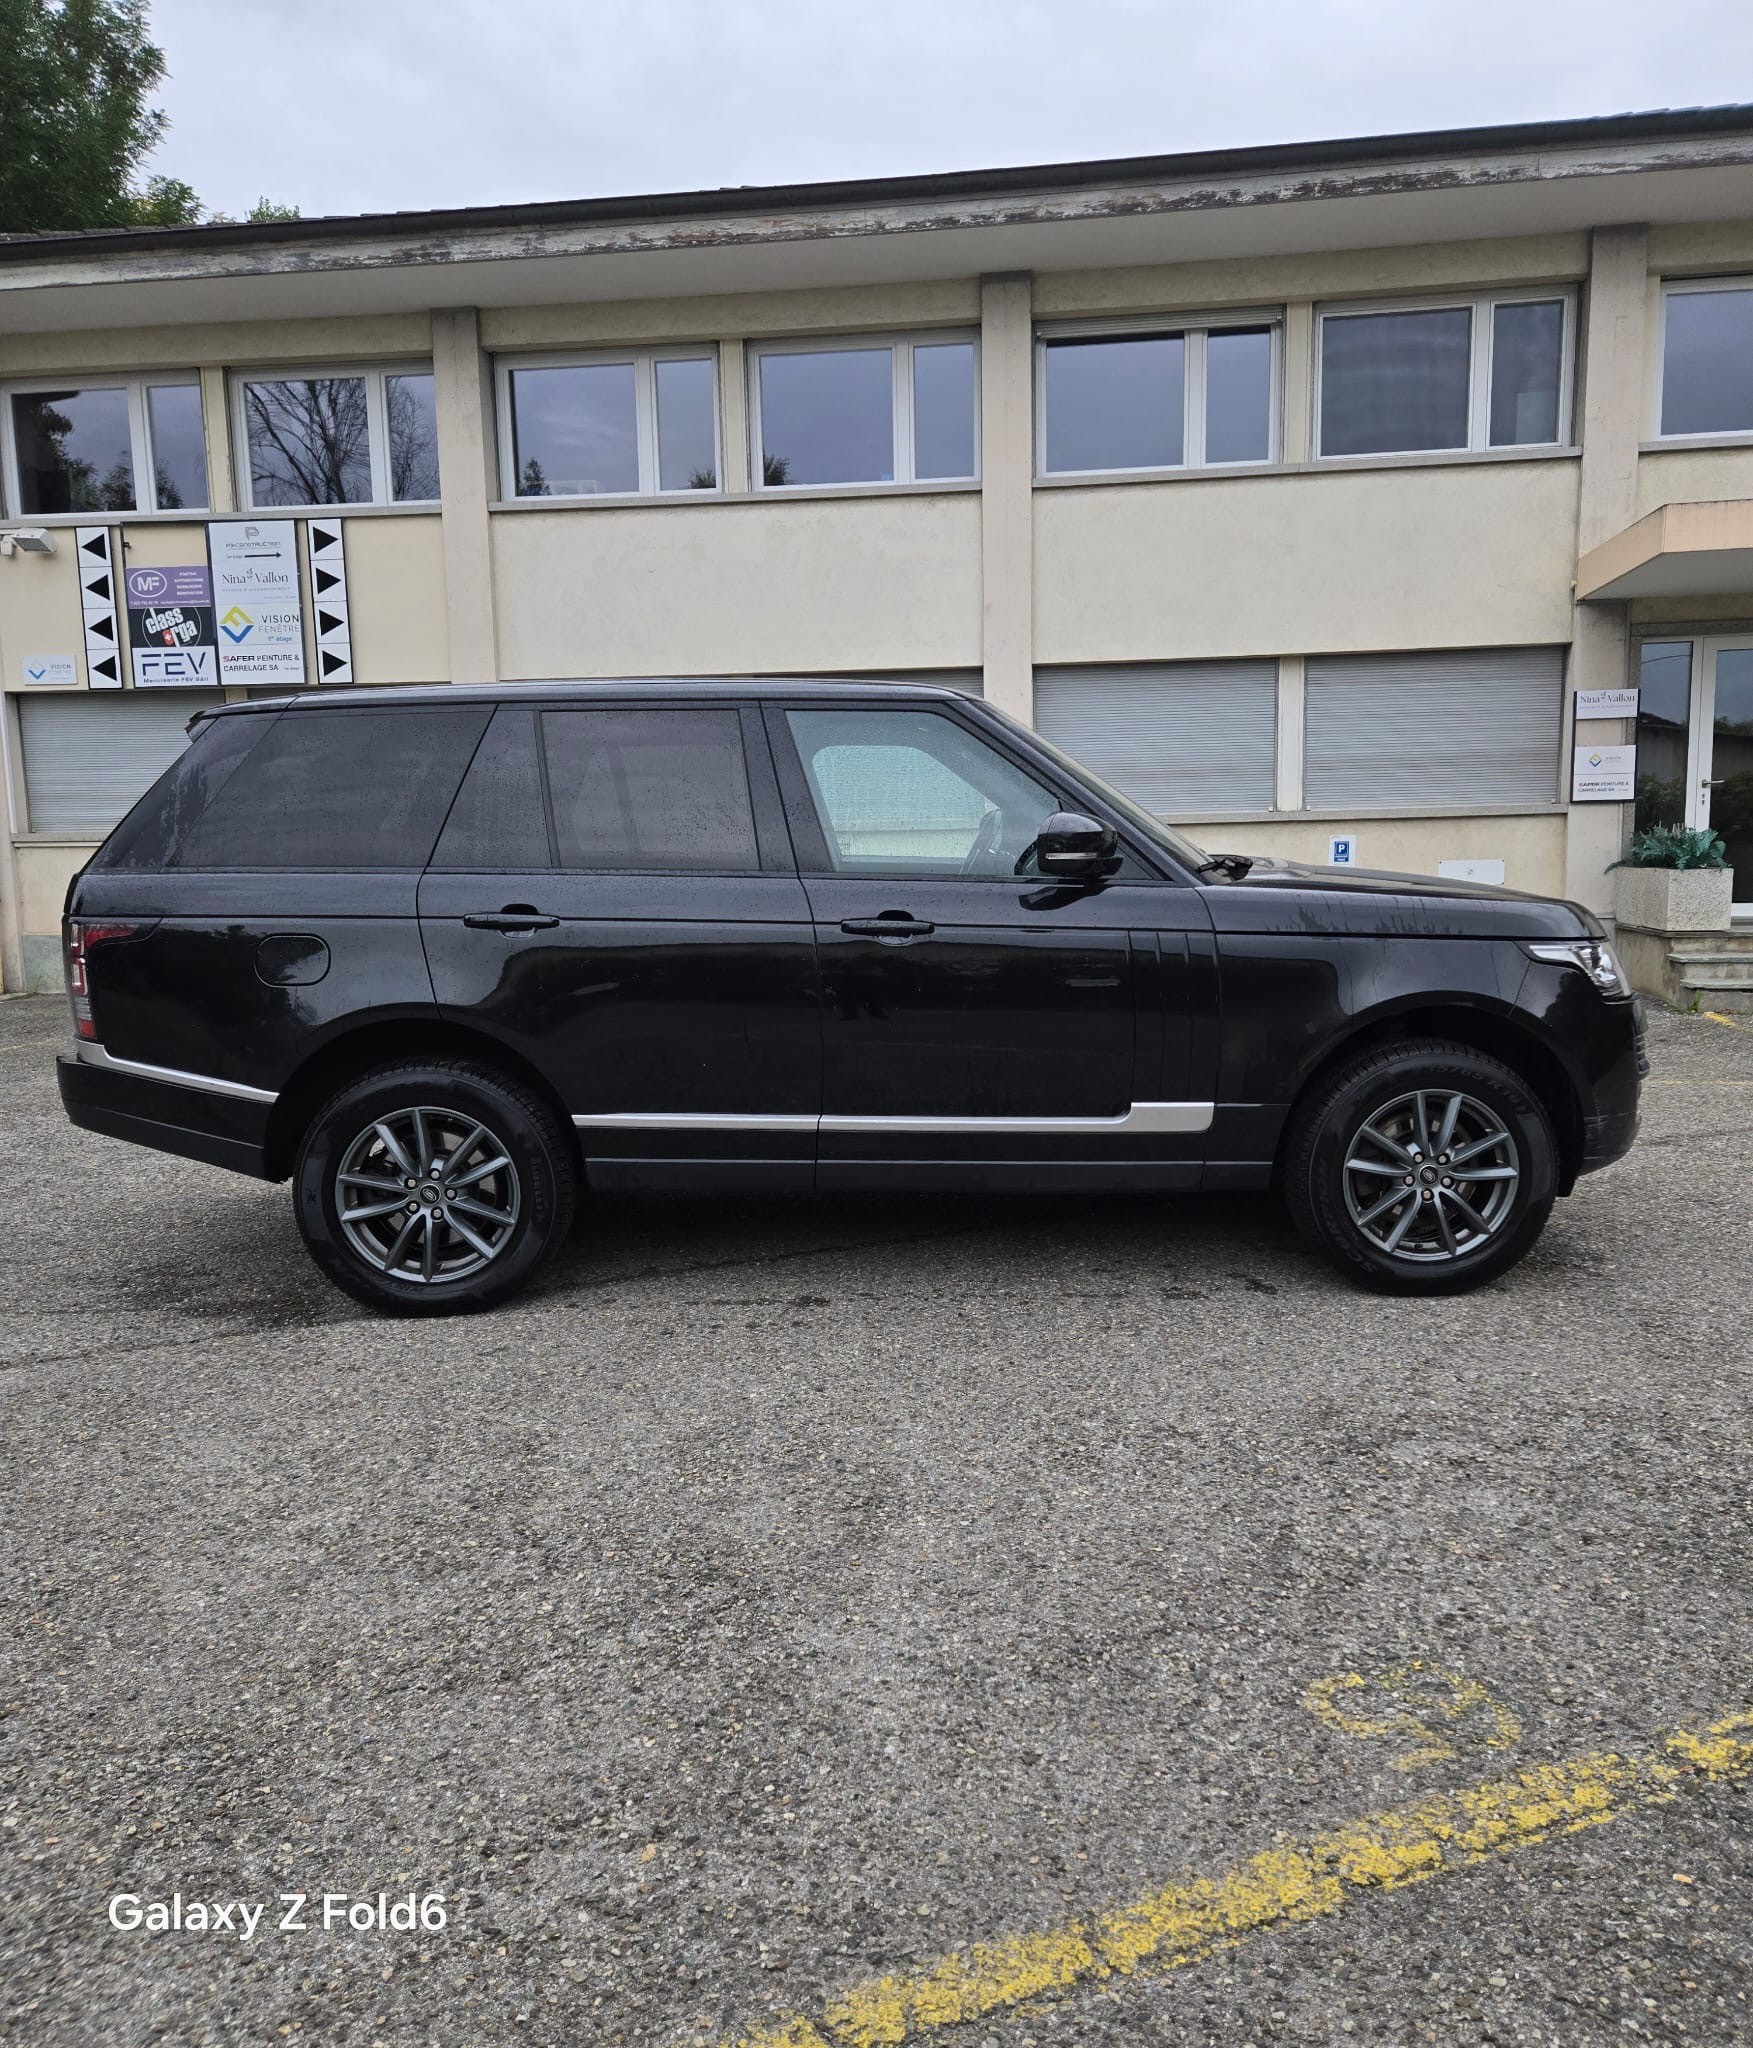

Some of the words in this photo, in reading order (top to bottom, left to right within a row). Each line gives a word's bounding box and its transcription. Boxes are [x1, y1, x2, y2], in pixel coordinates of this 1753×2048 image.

[221, 573, 247, 584] Nina
[254, 571, 289, 584] Vallon
[137, 576, 160, 591] MF
[145, 607, 184, 635] class
[261, 614, 300, 624] VISION
[141, 651, 207, 677] FEV
[223, 655, 255, 663] SAFER
[256, 654, 293, 662] PEINTURE
[223, 664, 267, 672] CARRELAGE
[1338, 844, 1346, 853] P
